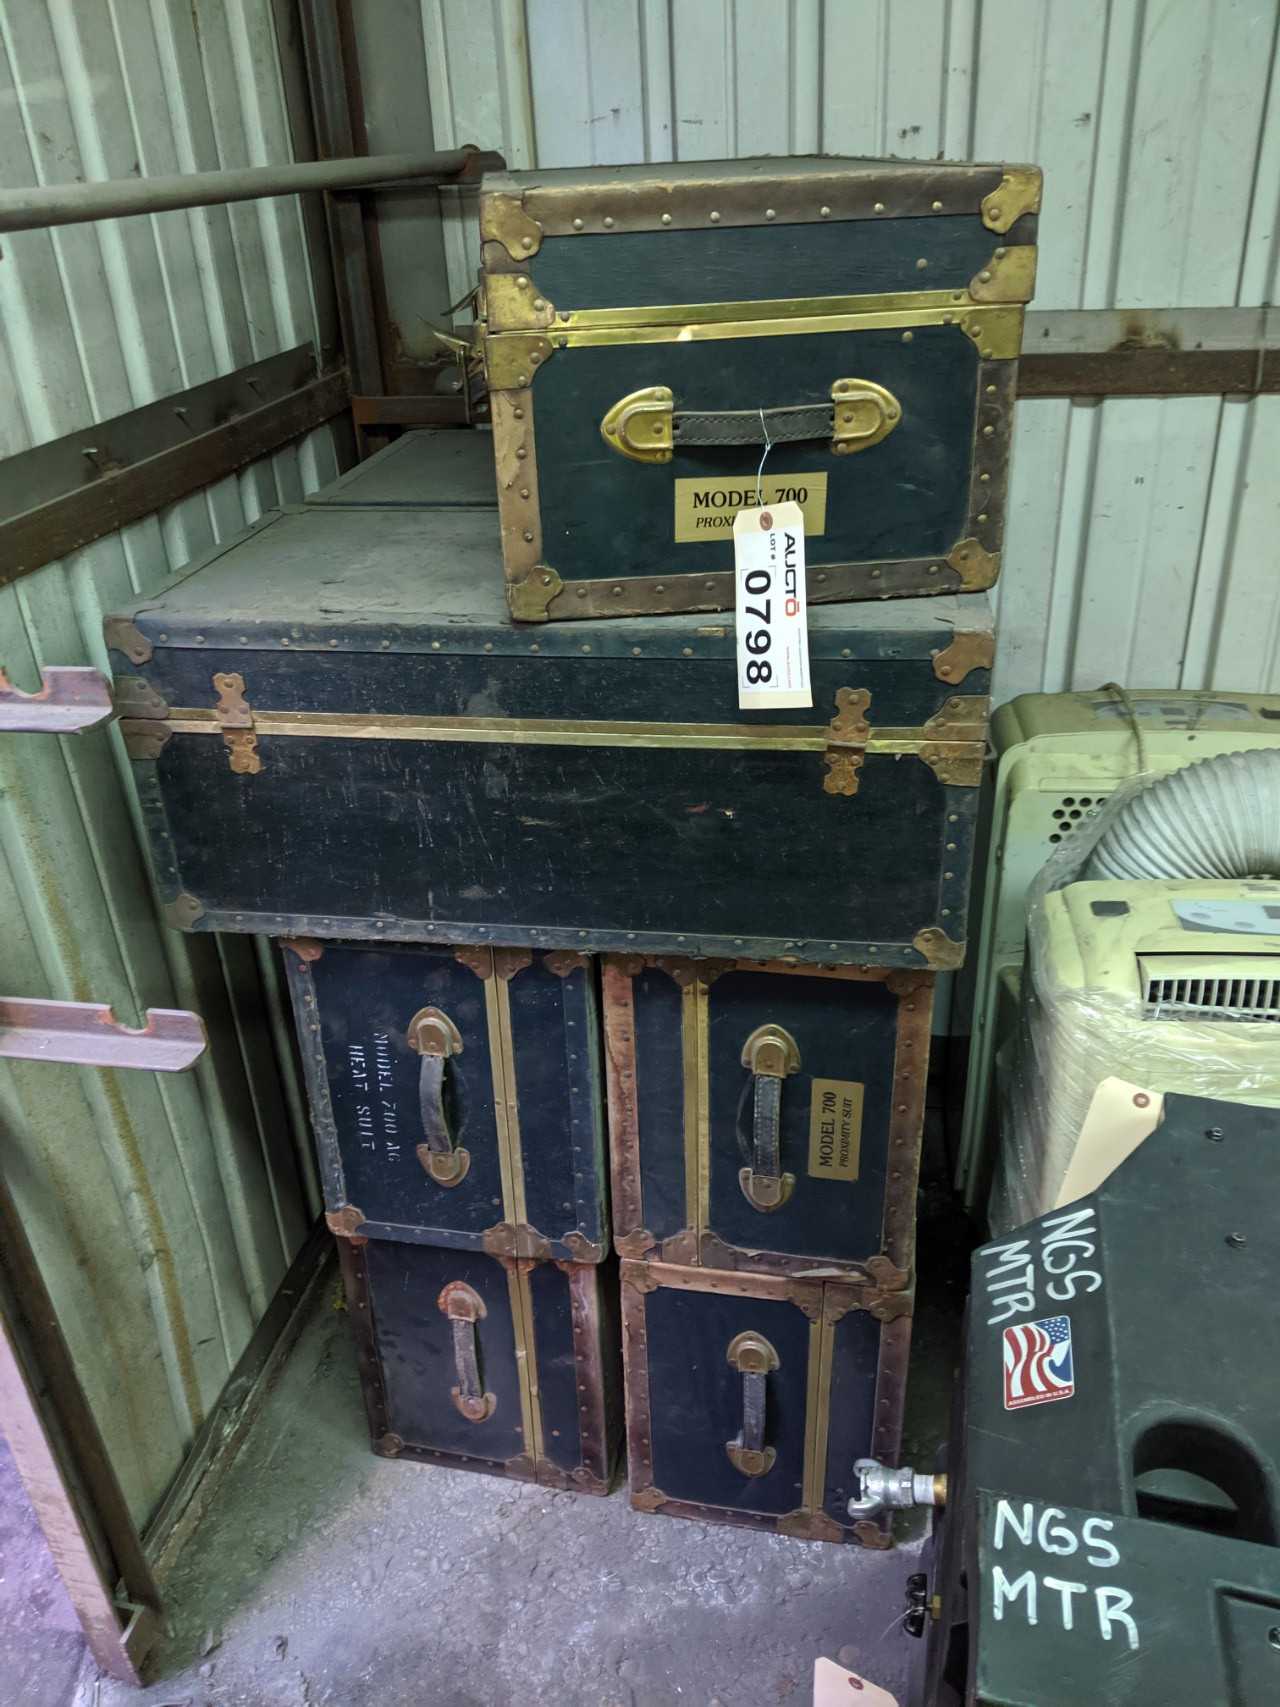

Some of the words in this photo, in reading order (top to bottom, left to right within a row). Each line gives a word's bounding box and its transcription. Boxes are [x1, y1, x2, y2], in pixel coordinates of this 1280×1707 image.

[693, 490, 768, 509] MODEL
[775, 487, 808, 504] 700
[696, 516, 736, 529] PROXI
[744, 569, 773, 685] 0798
[348, 1045, 368, 1092] HEAT
[373, 1032, 393, 1092] MODEL
[381, 1100, 397, 1134] 700
[822, 1091, 837, 1114] 700
[842, 1098, 853, 1119] SUIT
[356, 1105, 375, 1151] SUIT
[819, 1119, 835, 1167] MODEL
[1040, 1208, 1102, 1300] NGS
[979, 1239, 1036, 1325] MTR
[993, 1500, 1121, 1568] NGS
[992, 1566, 1140, 1650] MTR
